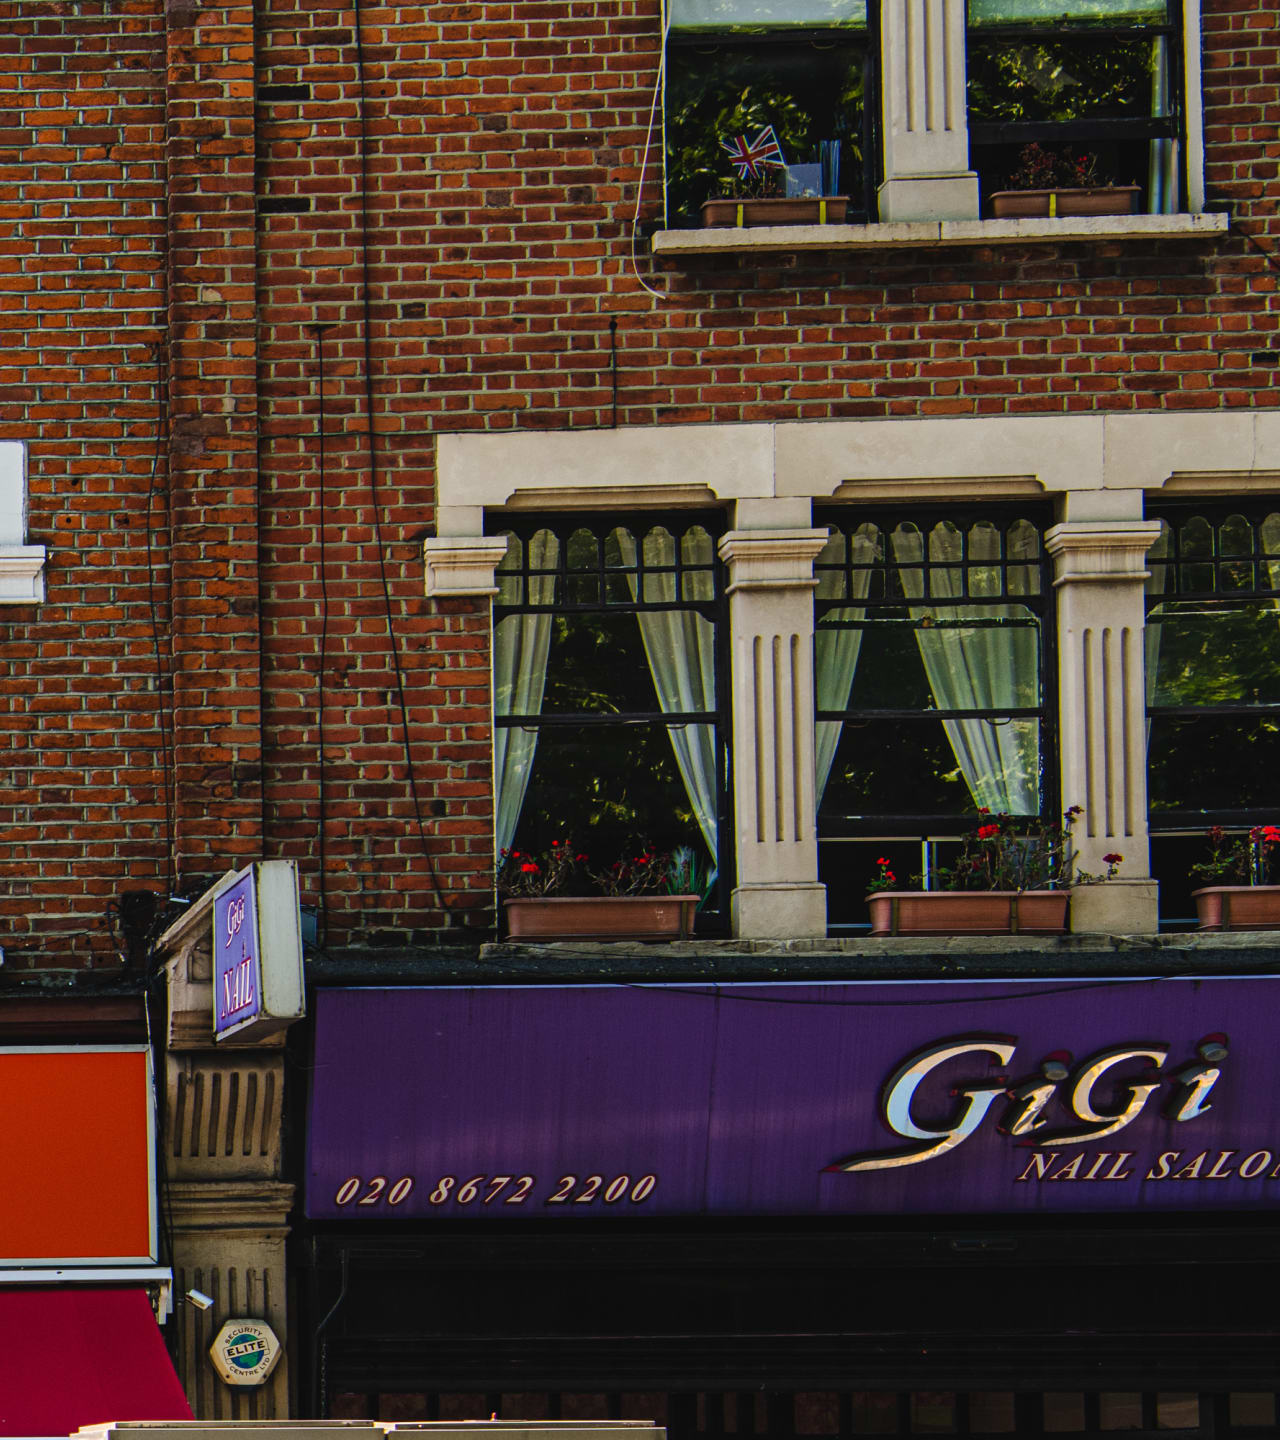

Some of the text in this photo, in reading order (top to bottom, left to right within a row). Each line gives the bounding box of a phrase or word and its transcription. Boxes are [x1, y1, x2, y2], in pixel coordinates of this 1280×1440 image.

[225, 894, 245, 949] GiGi
[221, 957, 254, 1020] NAIL
[824, 1030, 1230, 1173] GiGi
[1017, 1147, 1280, 1184] NAIL SALO
[334, 1172, 659, 1208] 020 8672 2200
[225, 1326, 263, 1345] SECURITY
[226, 1340, 266, 1357] ELITE
[229, 1357, 270, 1377] CENTRE LTD
